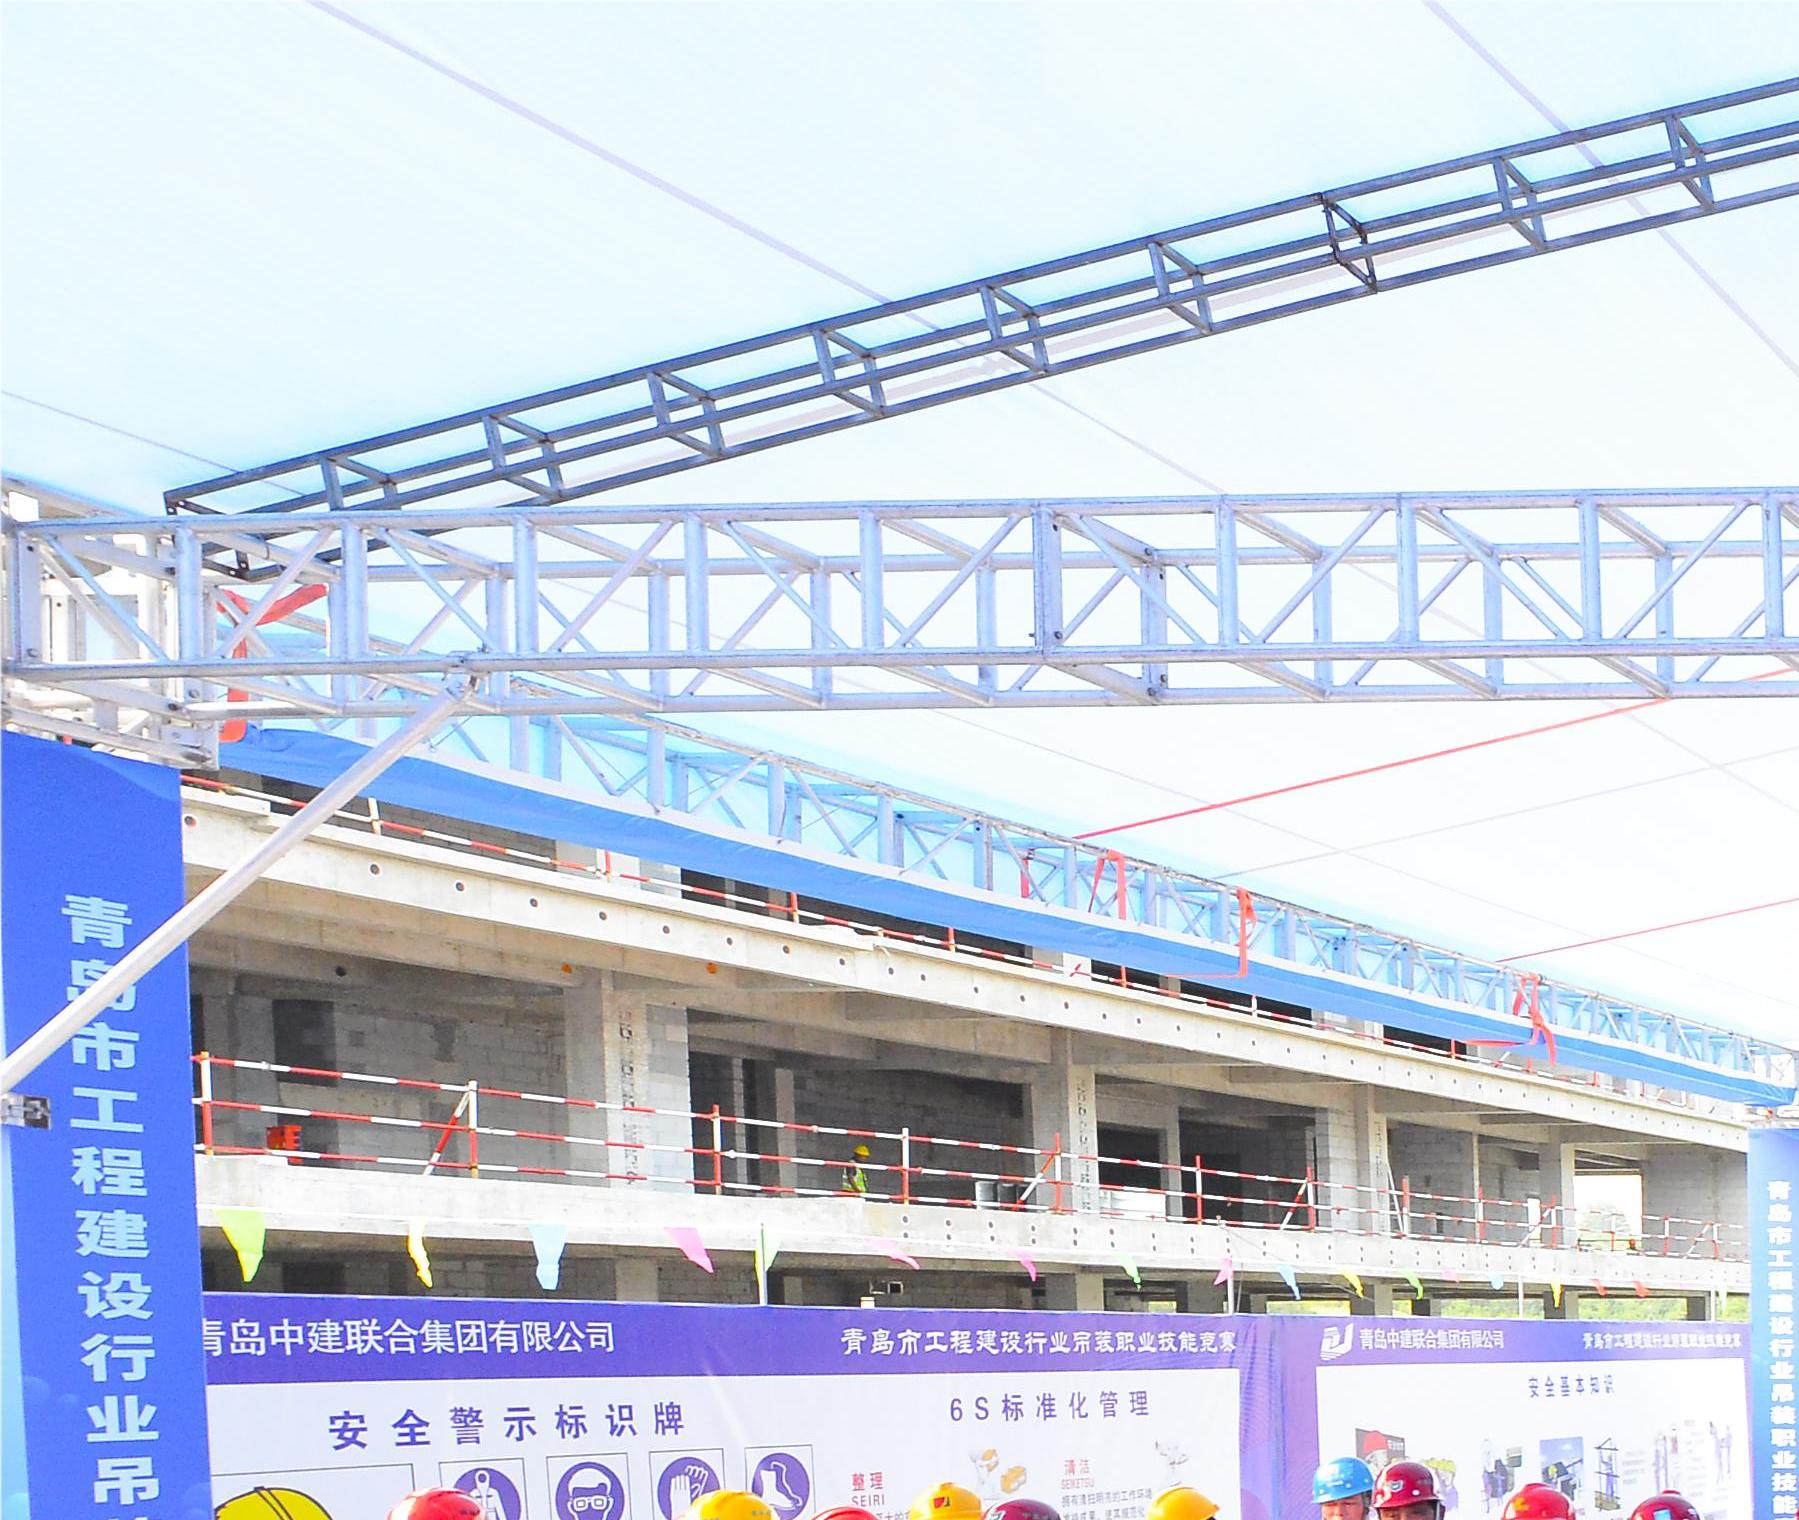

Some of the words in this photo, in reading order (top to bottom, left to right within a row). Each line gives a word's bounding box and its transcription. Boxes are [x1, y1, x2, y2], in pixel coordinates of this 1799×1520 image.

[204, 1319, 616, 1357] 青岛中建联合集团有限公司
[841, 1328, 1236, 1357] 青岛市工程建设行业吊装职业技能竞赛
[1360, 1328, 1505, 1350] 青岛中建联合集团有限公司
[1528, 1375, 1615, 1399] 安全基本知识
[329, 1402, 685, 1450] 安全警示标识牌
[852, 1472, 883, 1491] 整理
[851, 1494, 885, 1507] SEIRI
